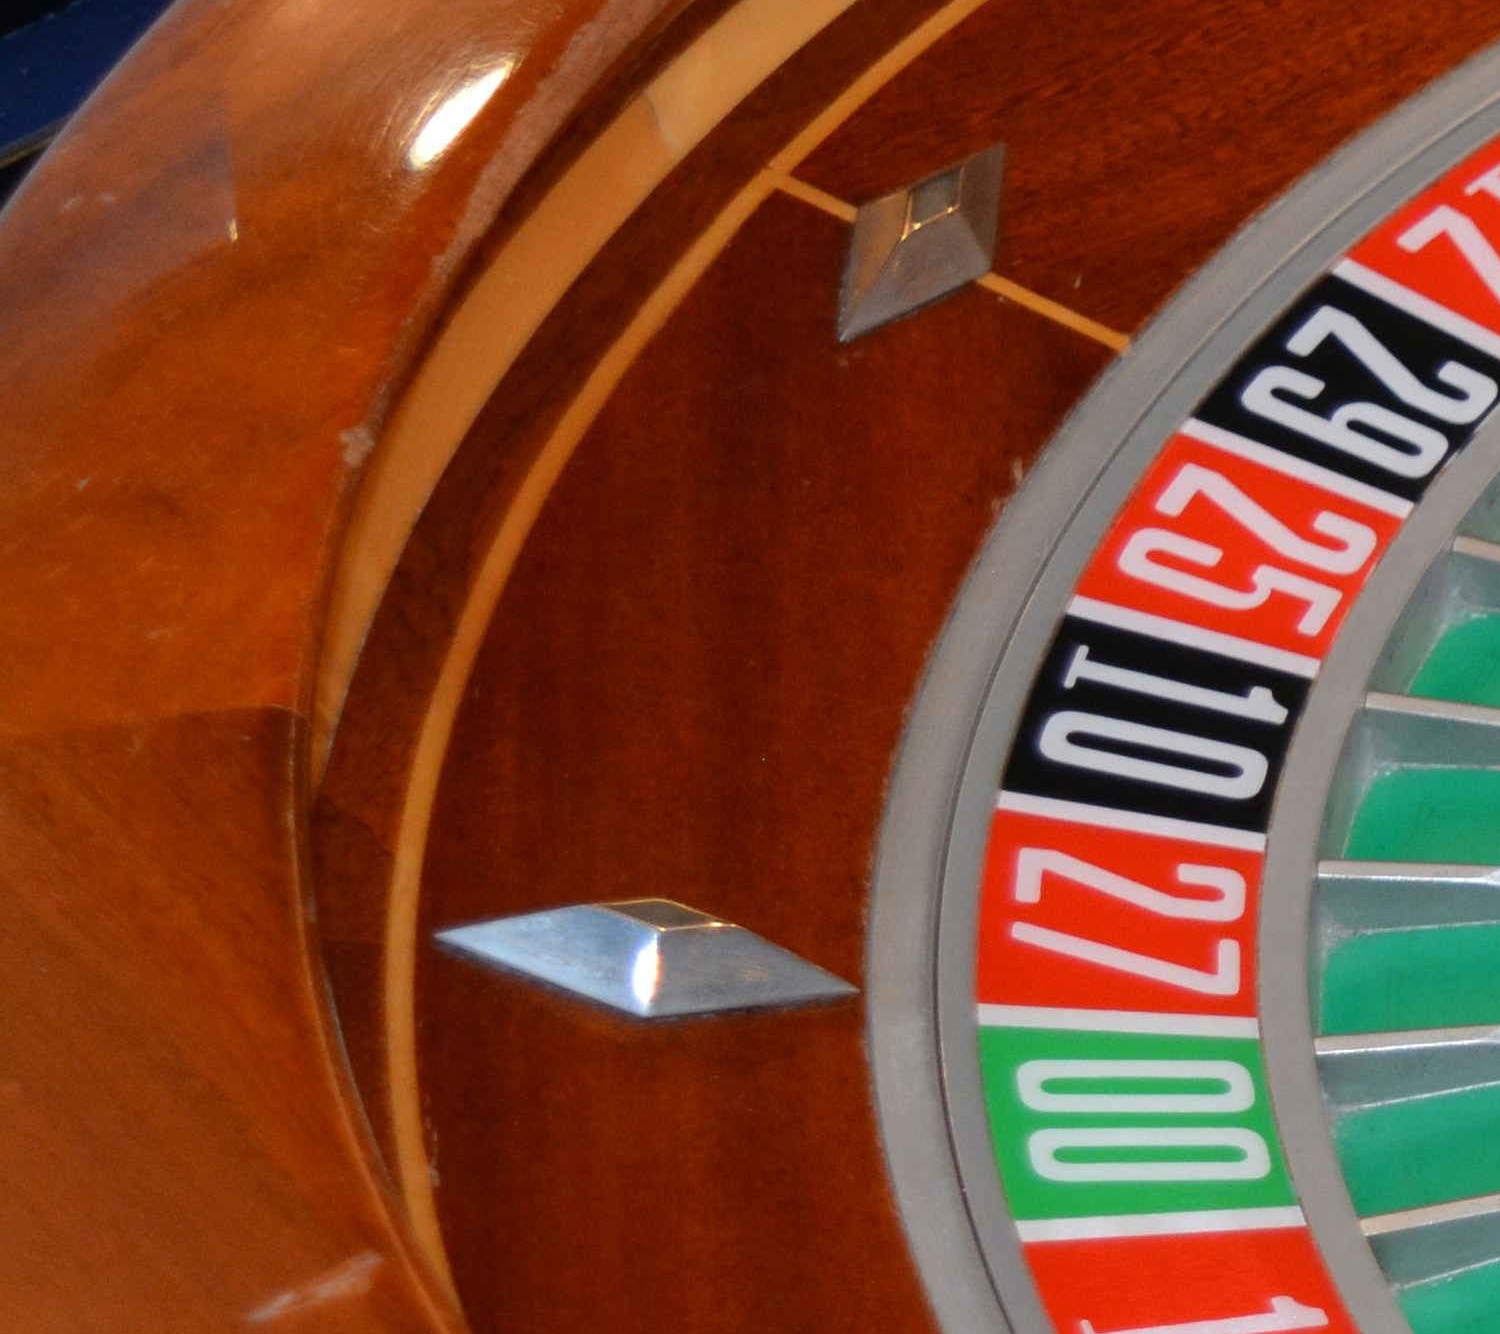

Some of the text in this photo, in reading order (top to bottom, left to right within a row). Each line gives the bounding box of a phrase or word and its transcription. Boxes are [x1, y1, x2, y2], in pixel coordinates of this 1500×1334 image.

[1240, 304, 1499, 479] 29
[1116, 462, 1378, 637] 25
[1038, 644, 1290, 800] 10
[1010, 846, 1247, 997] 27
[1014, 1058, 1272, 1184] 00
